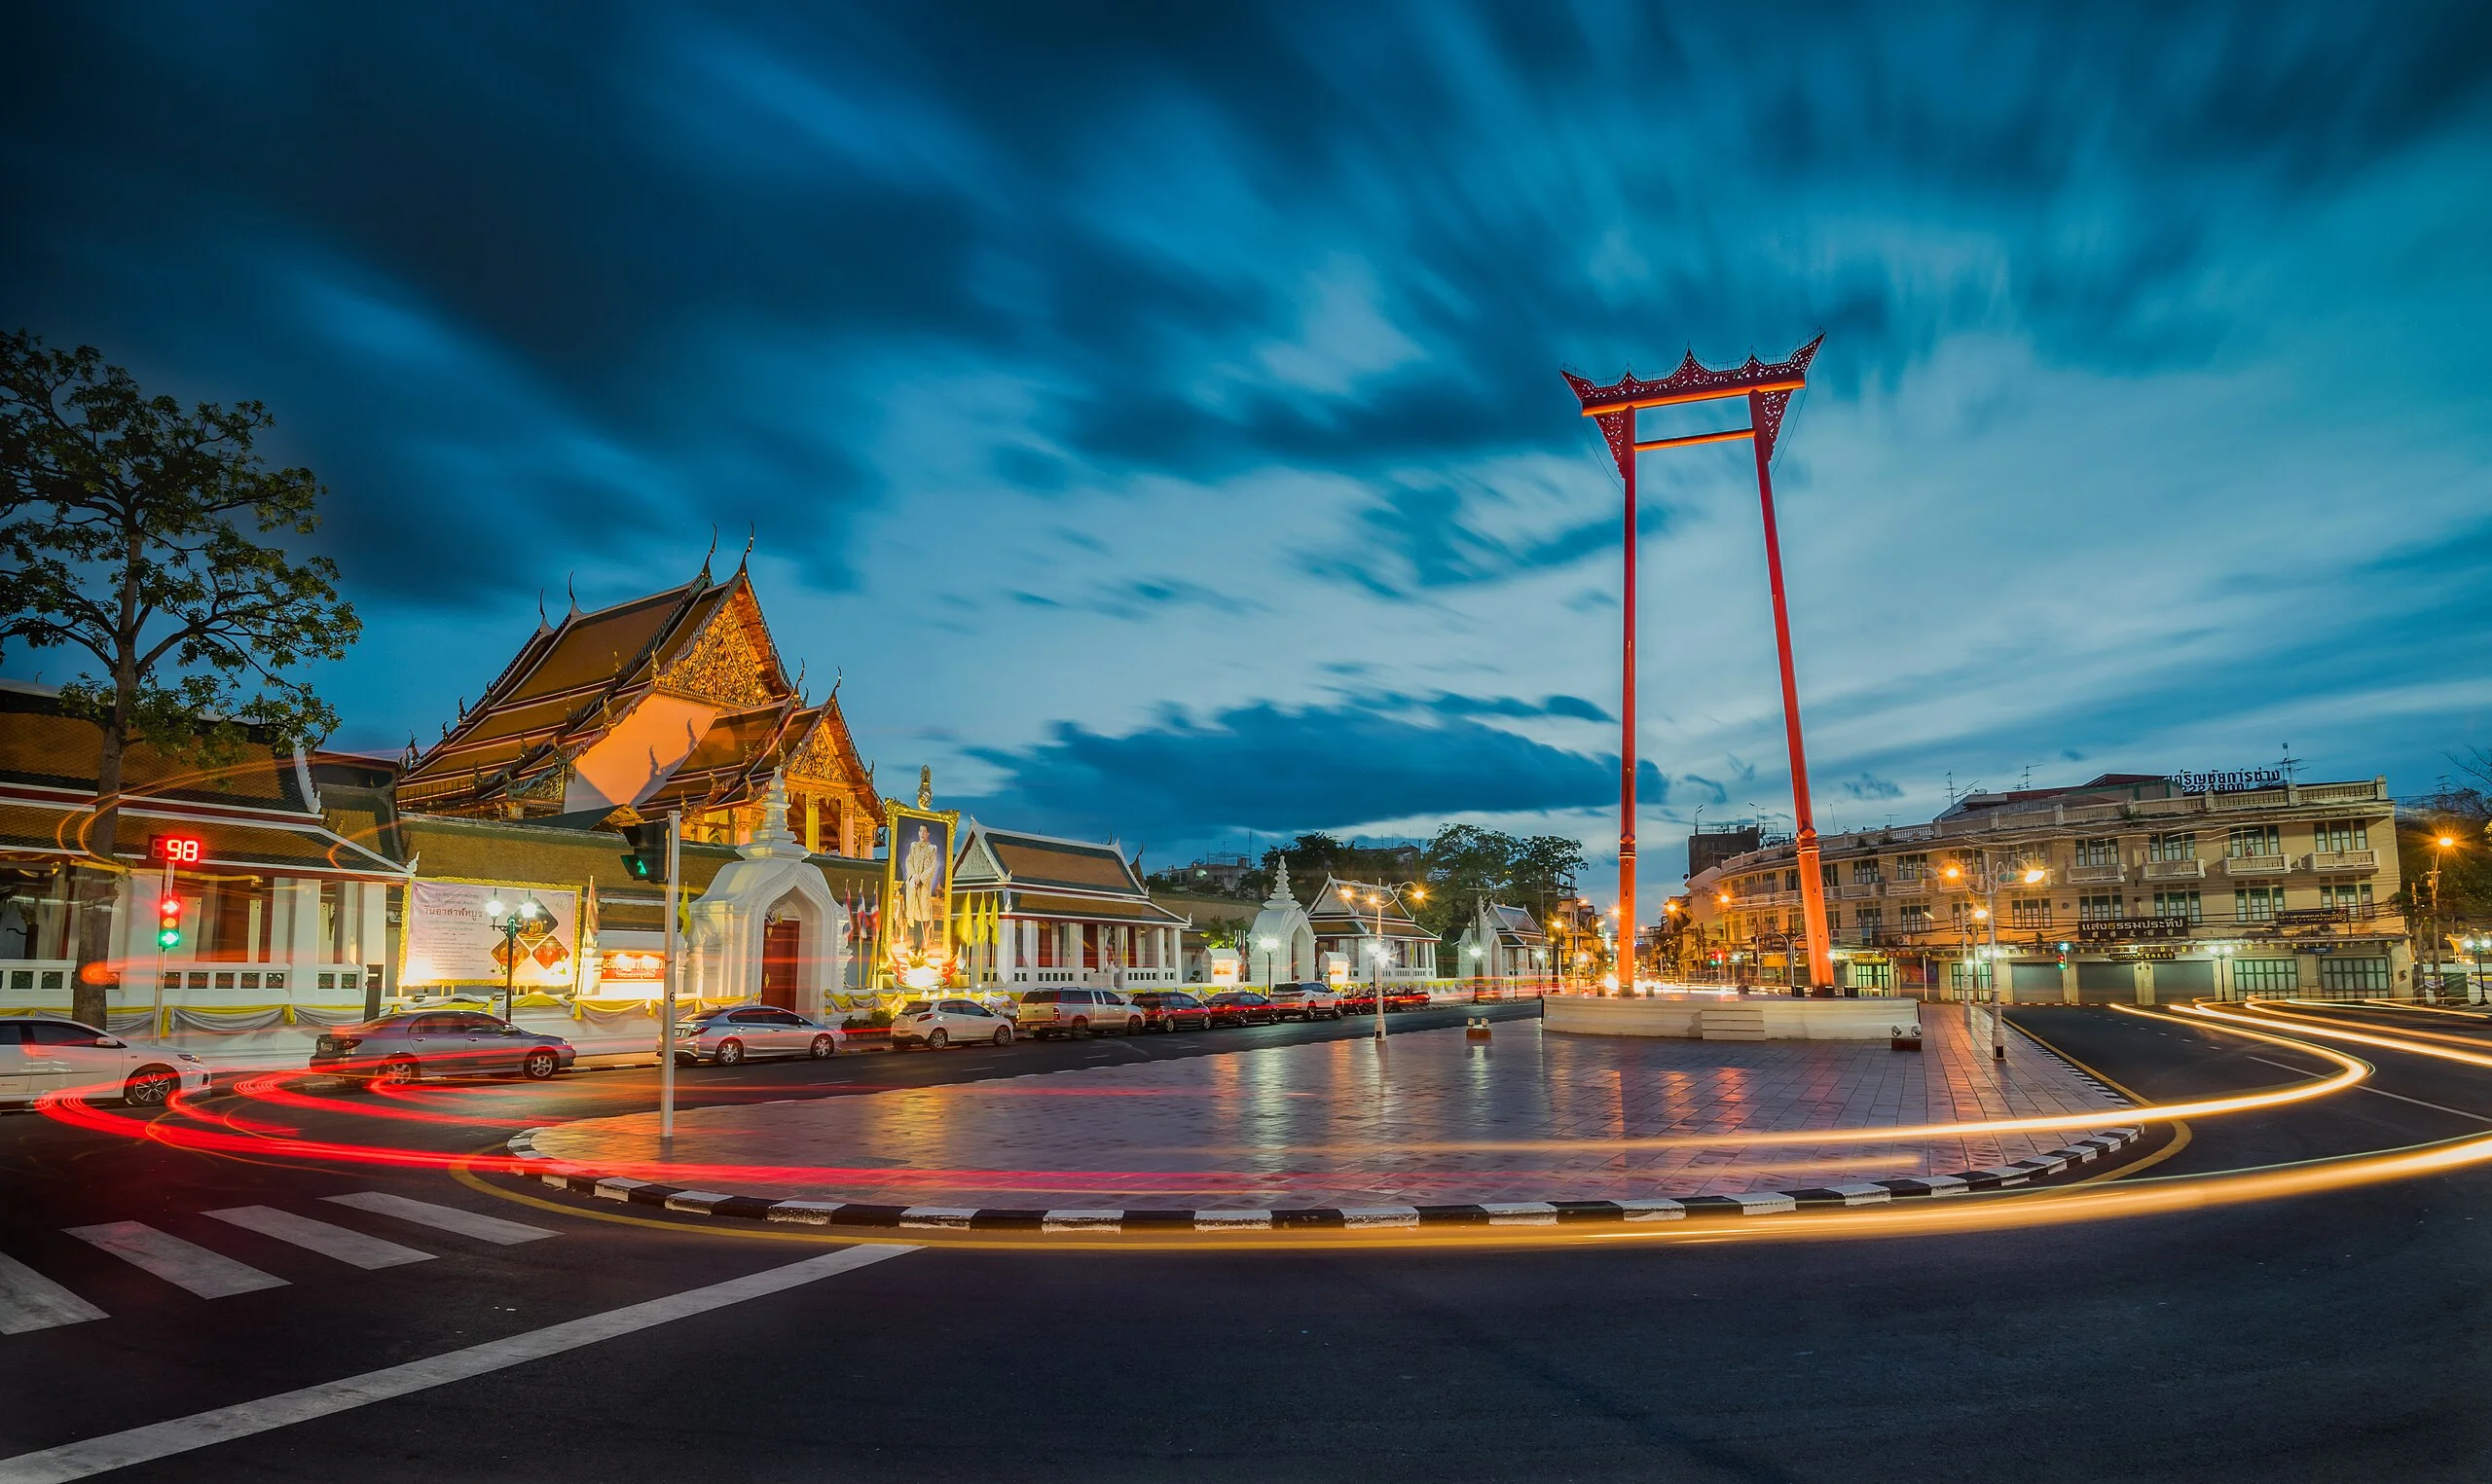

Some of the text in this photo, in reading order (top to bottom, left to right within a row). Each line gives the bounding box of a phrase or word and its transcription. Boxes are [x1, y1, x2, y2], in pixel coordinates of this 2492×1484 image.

[2082, 918, 2183, 931] แสงธรรมประทีป
[669, 992, 676, 1002] 6
